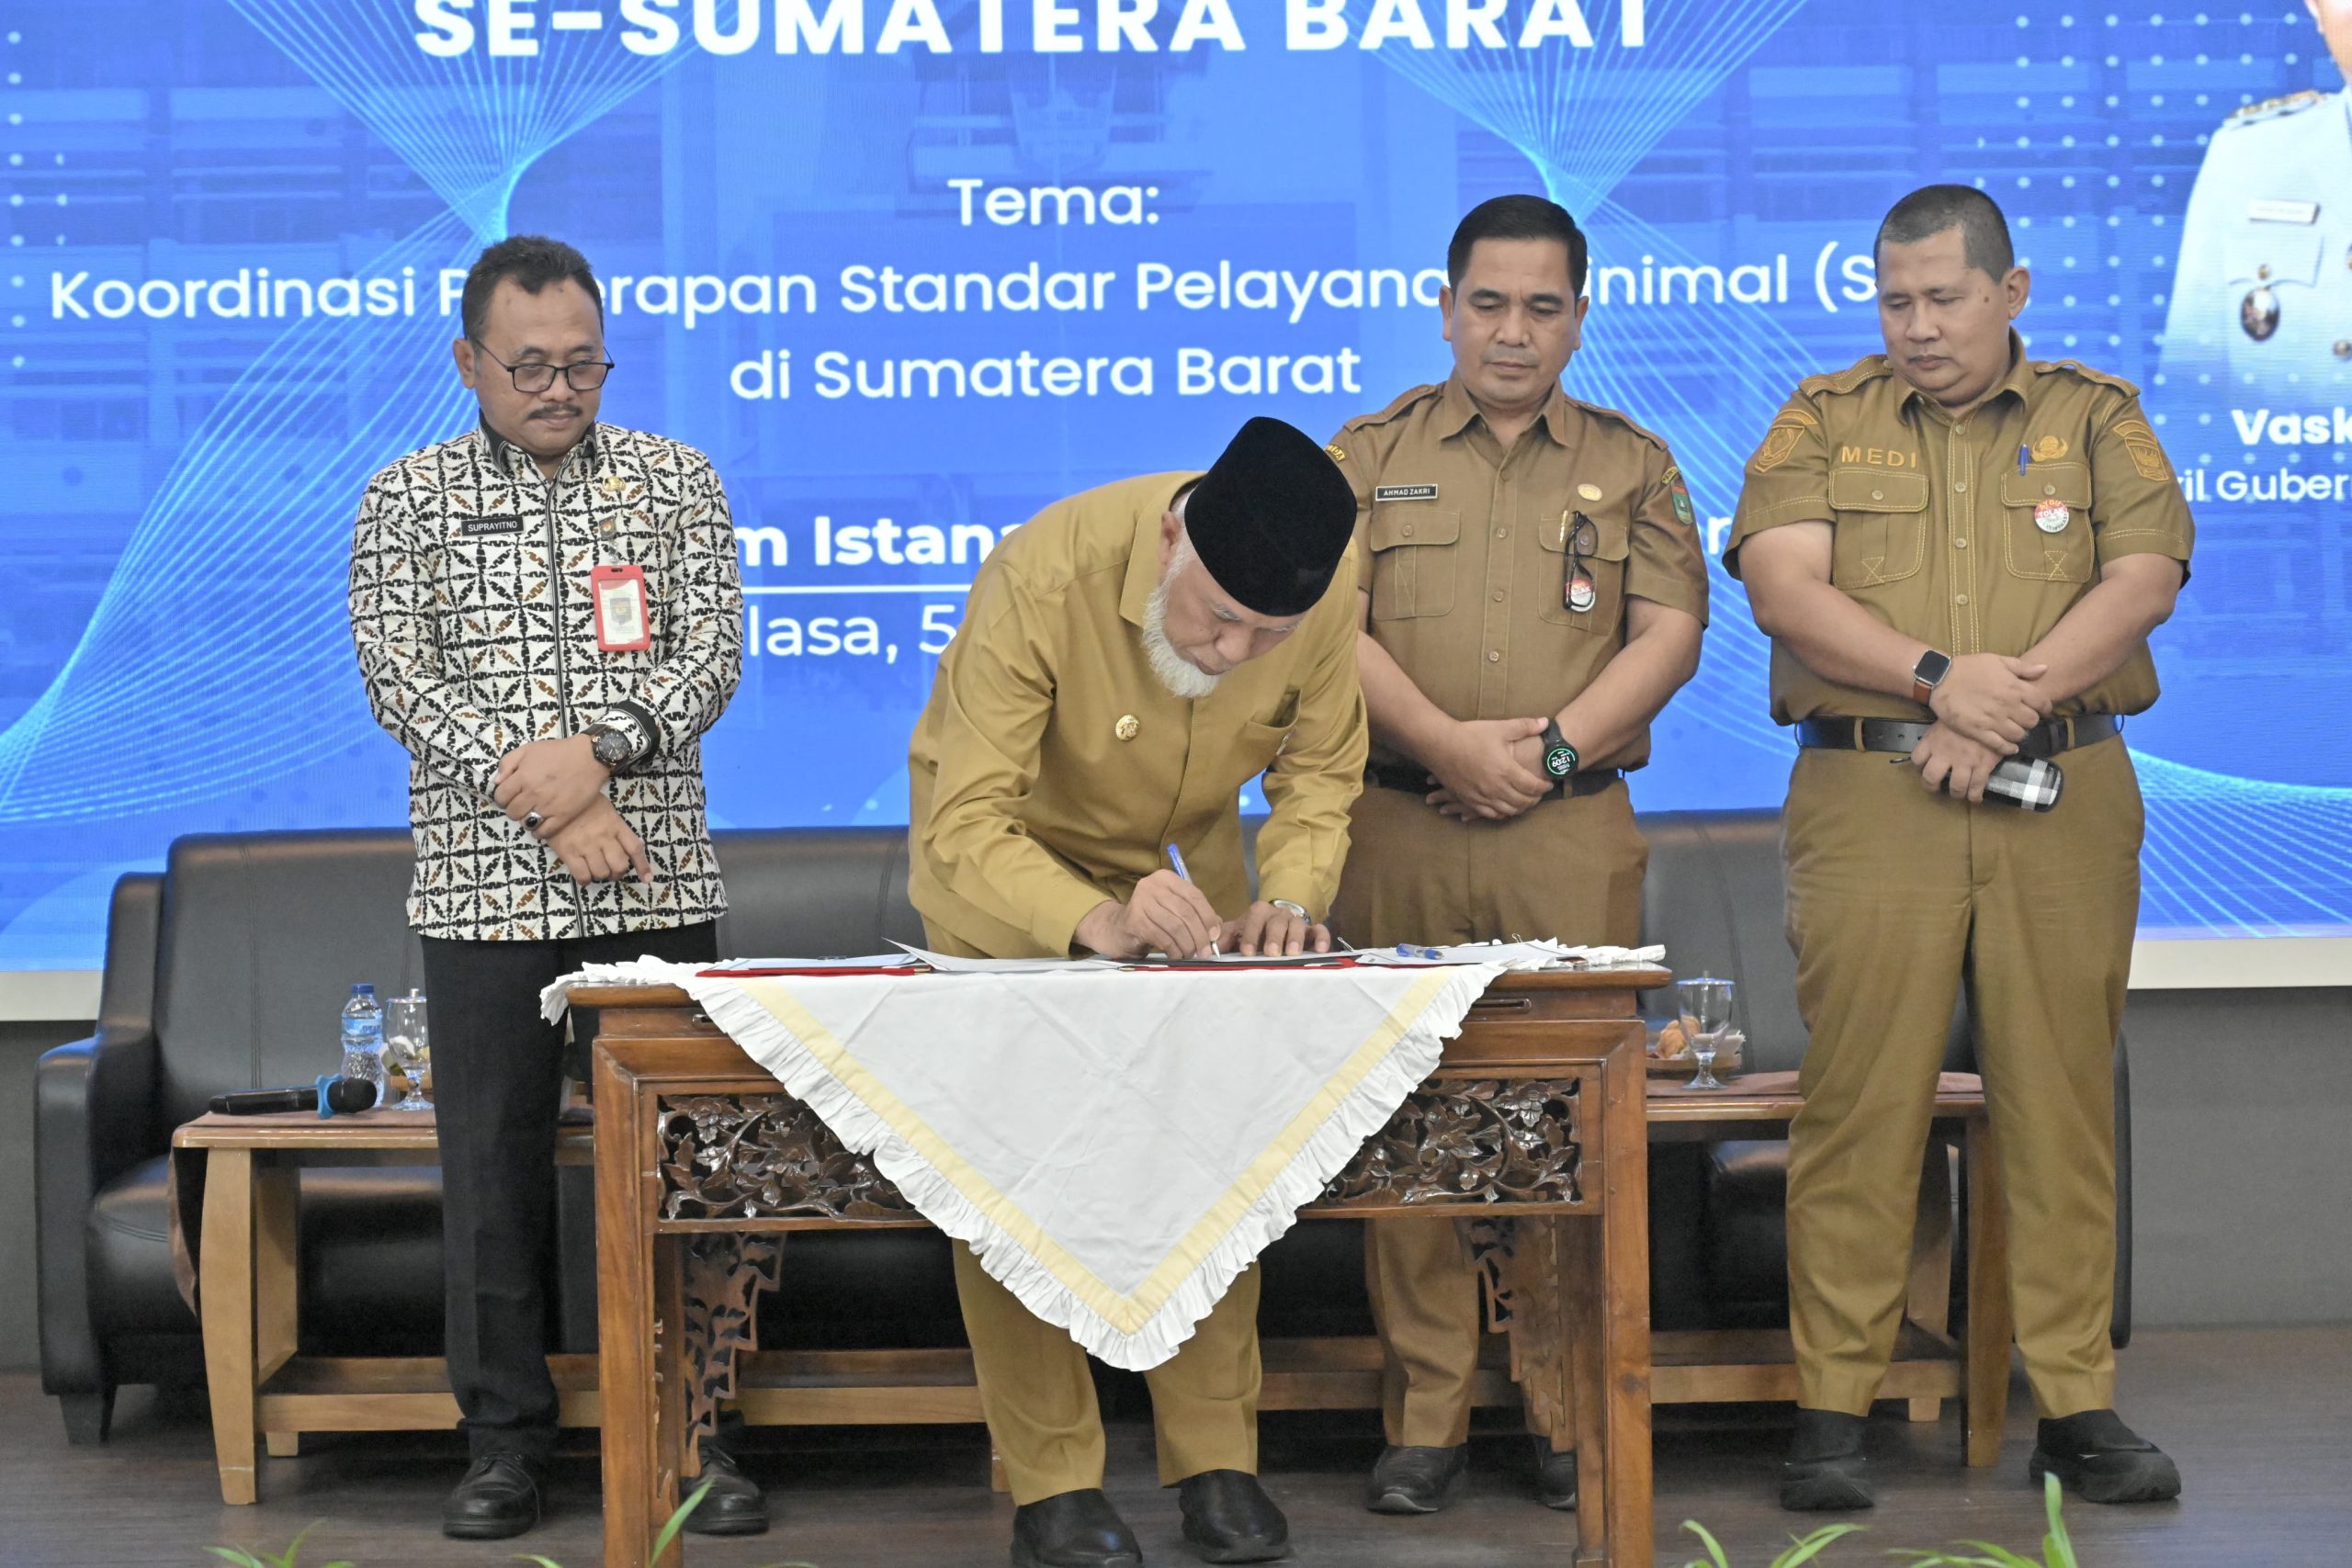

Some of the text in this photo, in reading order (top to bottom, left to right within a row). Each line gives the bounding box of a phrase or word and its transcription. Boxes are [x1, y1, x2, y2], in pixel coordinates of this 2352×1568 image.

[946, 178, 1159, 226] Tema:
[51, 265, 415, 319] Koordinasi
[438, 267, 817, 330] Prapan
[840, 261, 1116, 313] Standar
[1136, 259, 1451, 324] Pelayana
[1581, 253, 1788, 306] inimal
[729, 346, 1362, 400] di Sumatera Barat
[1840, 446, 1917, 469] MEDI
[1383, 489, 1408, 497] AHMAD
[2215, 467, 2352, 502] Guber
[468, 521, 517, 532] SUPRAYITNO
[814, 515, 1023, 567] Istan
